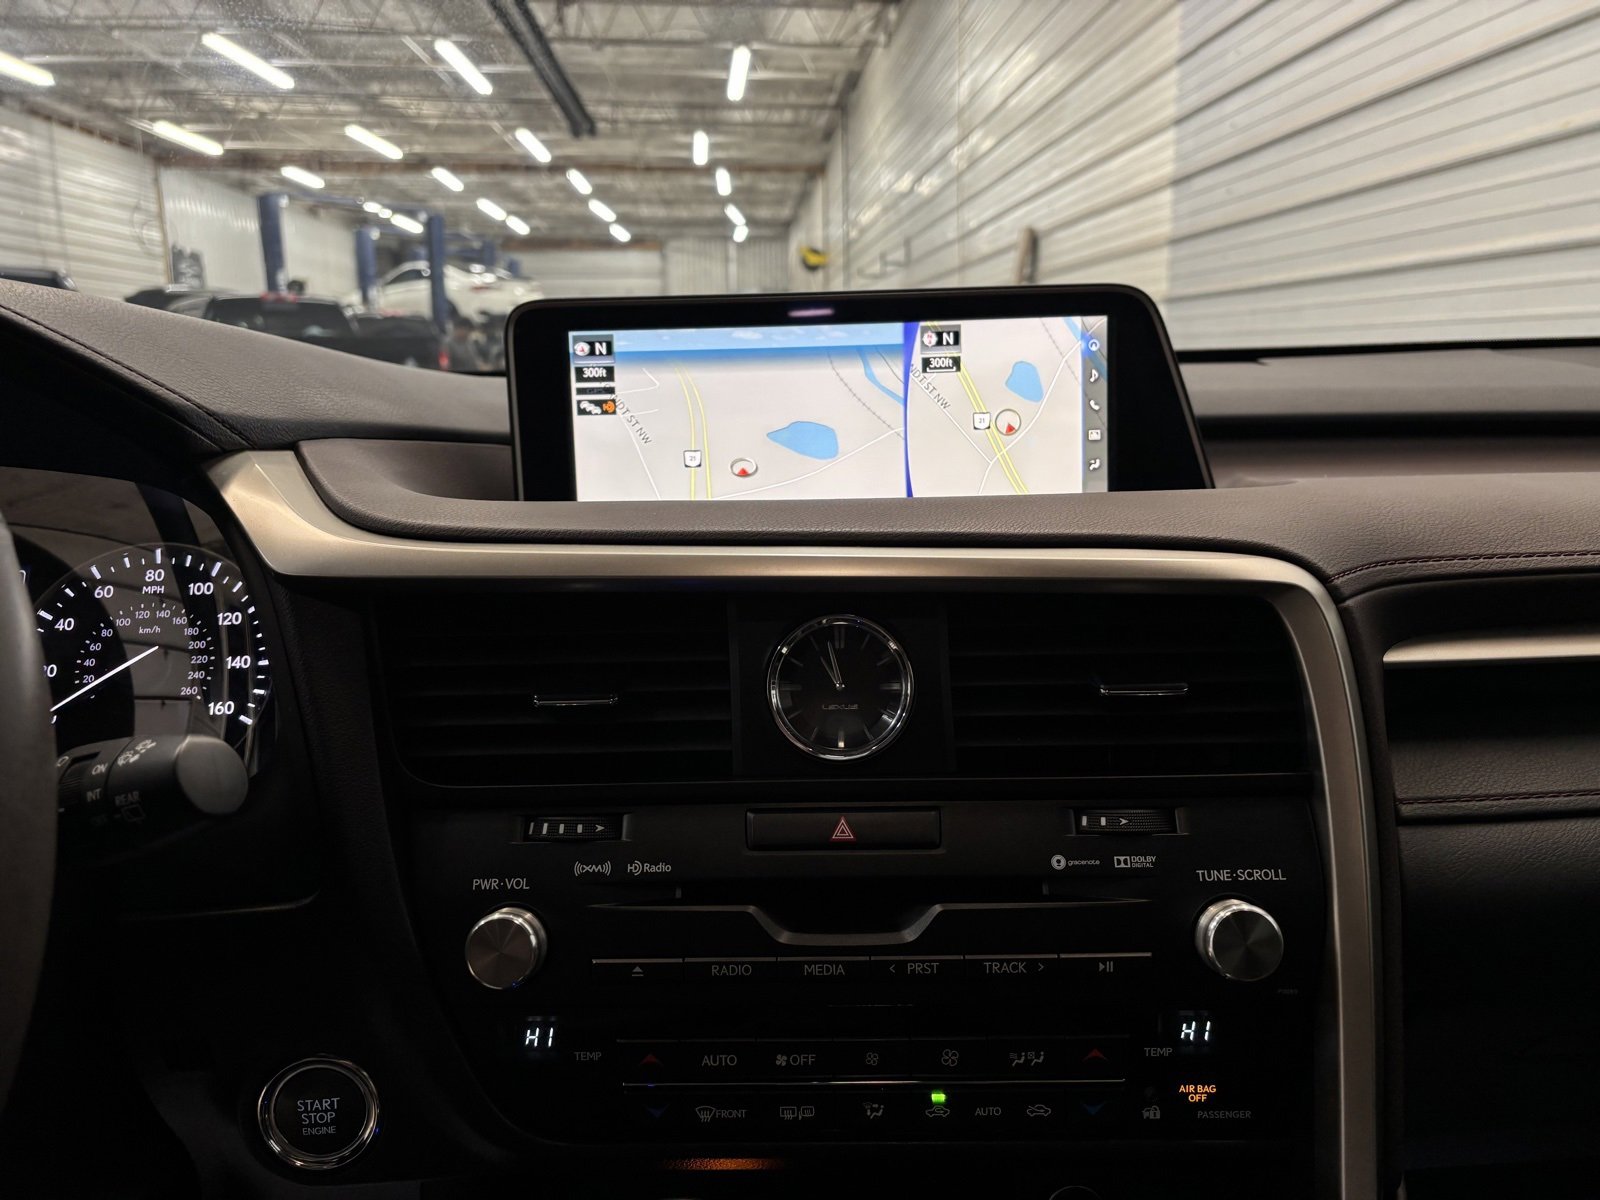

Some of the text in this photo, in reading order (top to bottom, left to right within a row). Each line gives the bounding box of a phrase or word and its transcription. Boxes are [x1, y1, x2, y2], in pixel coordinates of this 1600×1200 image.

[942, 332, 954, 345] N
[594, 342, 607, 355] N
[929, 358, 953, 368] 300ft
[582, 367, 607, 378] 300ft
[934, 393, 951, 409] NW
[636, 427, 652, 444] NW
[145, 570, 165, 582] 80
[94, 585, 114, 598] 60
[142, 586, 165, 594] MPH
[188, 582, 214, 595] 100
[135, 611, 150, 619] 120
[156, 610, 171, 618] 140
[217, 612, 242, 625] 120
[54, 618, 75, 631] 40
[116, 618, 131, 626] 100
[172, 617, 187, 625] 160
[101, 629, 113, 637] 80
[139, 626, 161, 634] km/h
[184, 628, 199, 636] 180
[90, 643, 101, 651] 60
[188, 641, 206, 649] 200
[83, 658, 95, 667] 40
[191, 655, 208, 664] 220
[225, 656, 251, 669] 140
[83, 674, 95, 683] 20
[187, 671, 205, 679] 240
[180, 687, 198, 695] 260
[208, 702, 235, 715] 160
[86, 788, 102, 802] INT
[115, 791, 140, 806] REAR
[643, 862, 672, 872] Radio
[711, 964, 752, 977] RADIO
[804, 964, 845, 976] MEDIA
[907, 962, 939, 974] PRST
[983, 962, 1027, 974] TRACK
[574, 1052, 602, 1061] TEMP
[1144, 1047, 1173, 1057] TEMP
[701, 1055, 738, 1067] AUTO
[790, 1055, 816, 1066] OFF
[1179, 1084, 1217, 1093] AIR BAG
[1188, 1094, 1207, 1102] OFF
[297, 1097, 340, 1112] START
[715, 1109, 747, 1119] FRONT
[975, 1107, 1001, 1116] AUTO
[1197, 1110, 1252, 1119] PASSENGER
[301, 1111, 336, 1124] STOP
[302, 1126, 336, 1136] ENGINE
